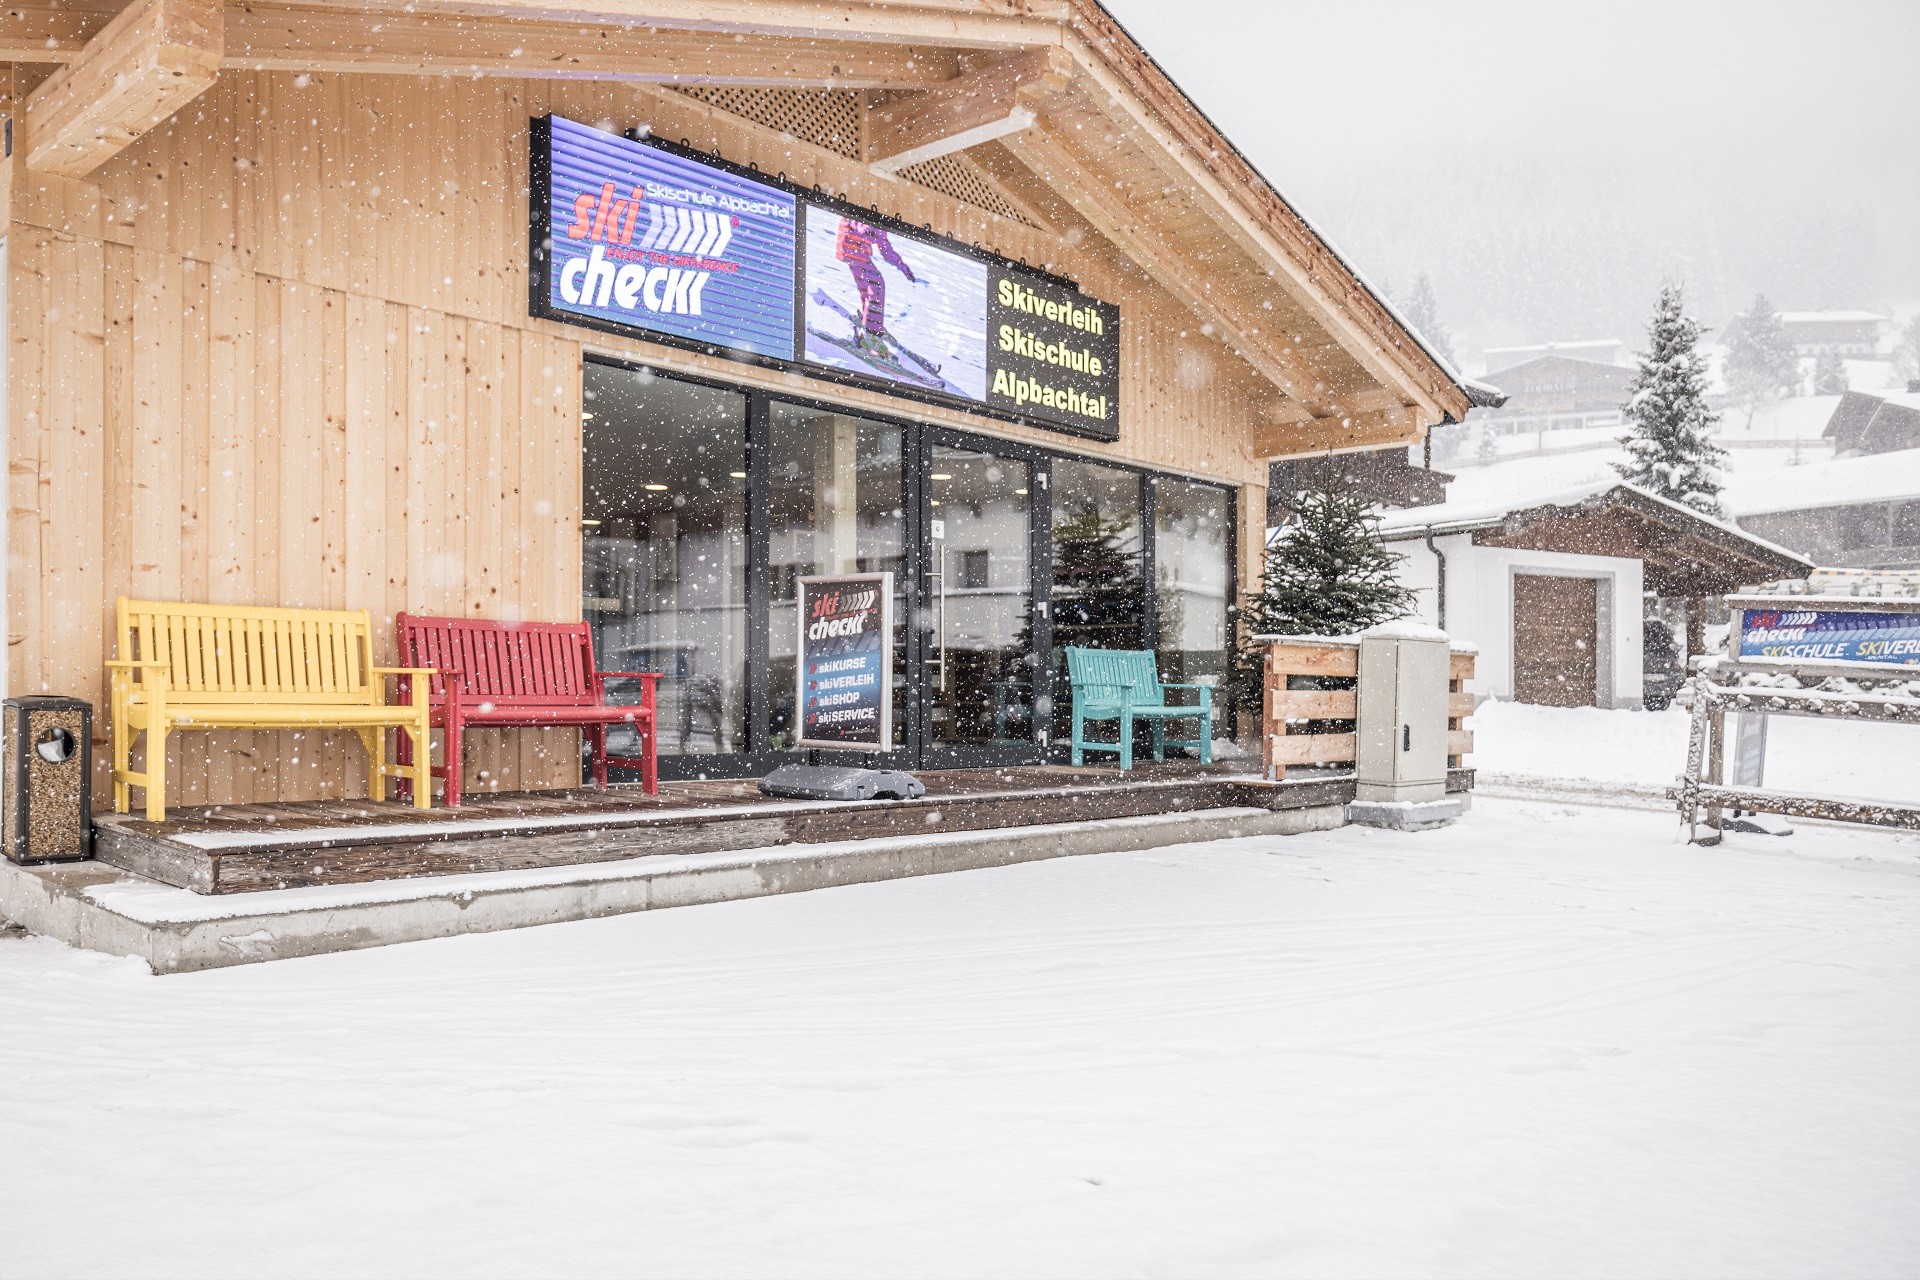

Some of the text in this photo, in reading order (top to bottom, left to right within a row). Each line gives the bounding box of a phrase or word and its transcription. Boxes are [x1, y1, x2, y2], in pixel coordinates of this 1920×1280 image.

[568, 182, 644, 245] ski
[646, 182, 790, 218] Skischule Alpbachtal
[606, 247, 645, 262] ENJOY
[649, 252, 670, 265] THE
[998, 279, 1103, 336] Skiverleih
[999, 324, 1102, 377] Skischule
[992, 368, 1106, 420] Alpbachtal
[812, 591, 839, 617] ski
[1762, 642, 1849, 658] SKISCHULE
